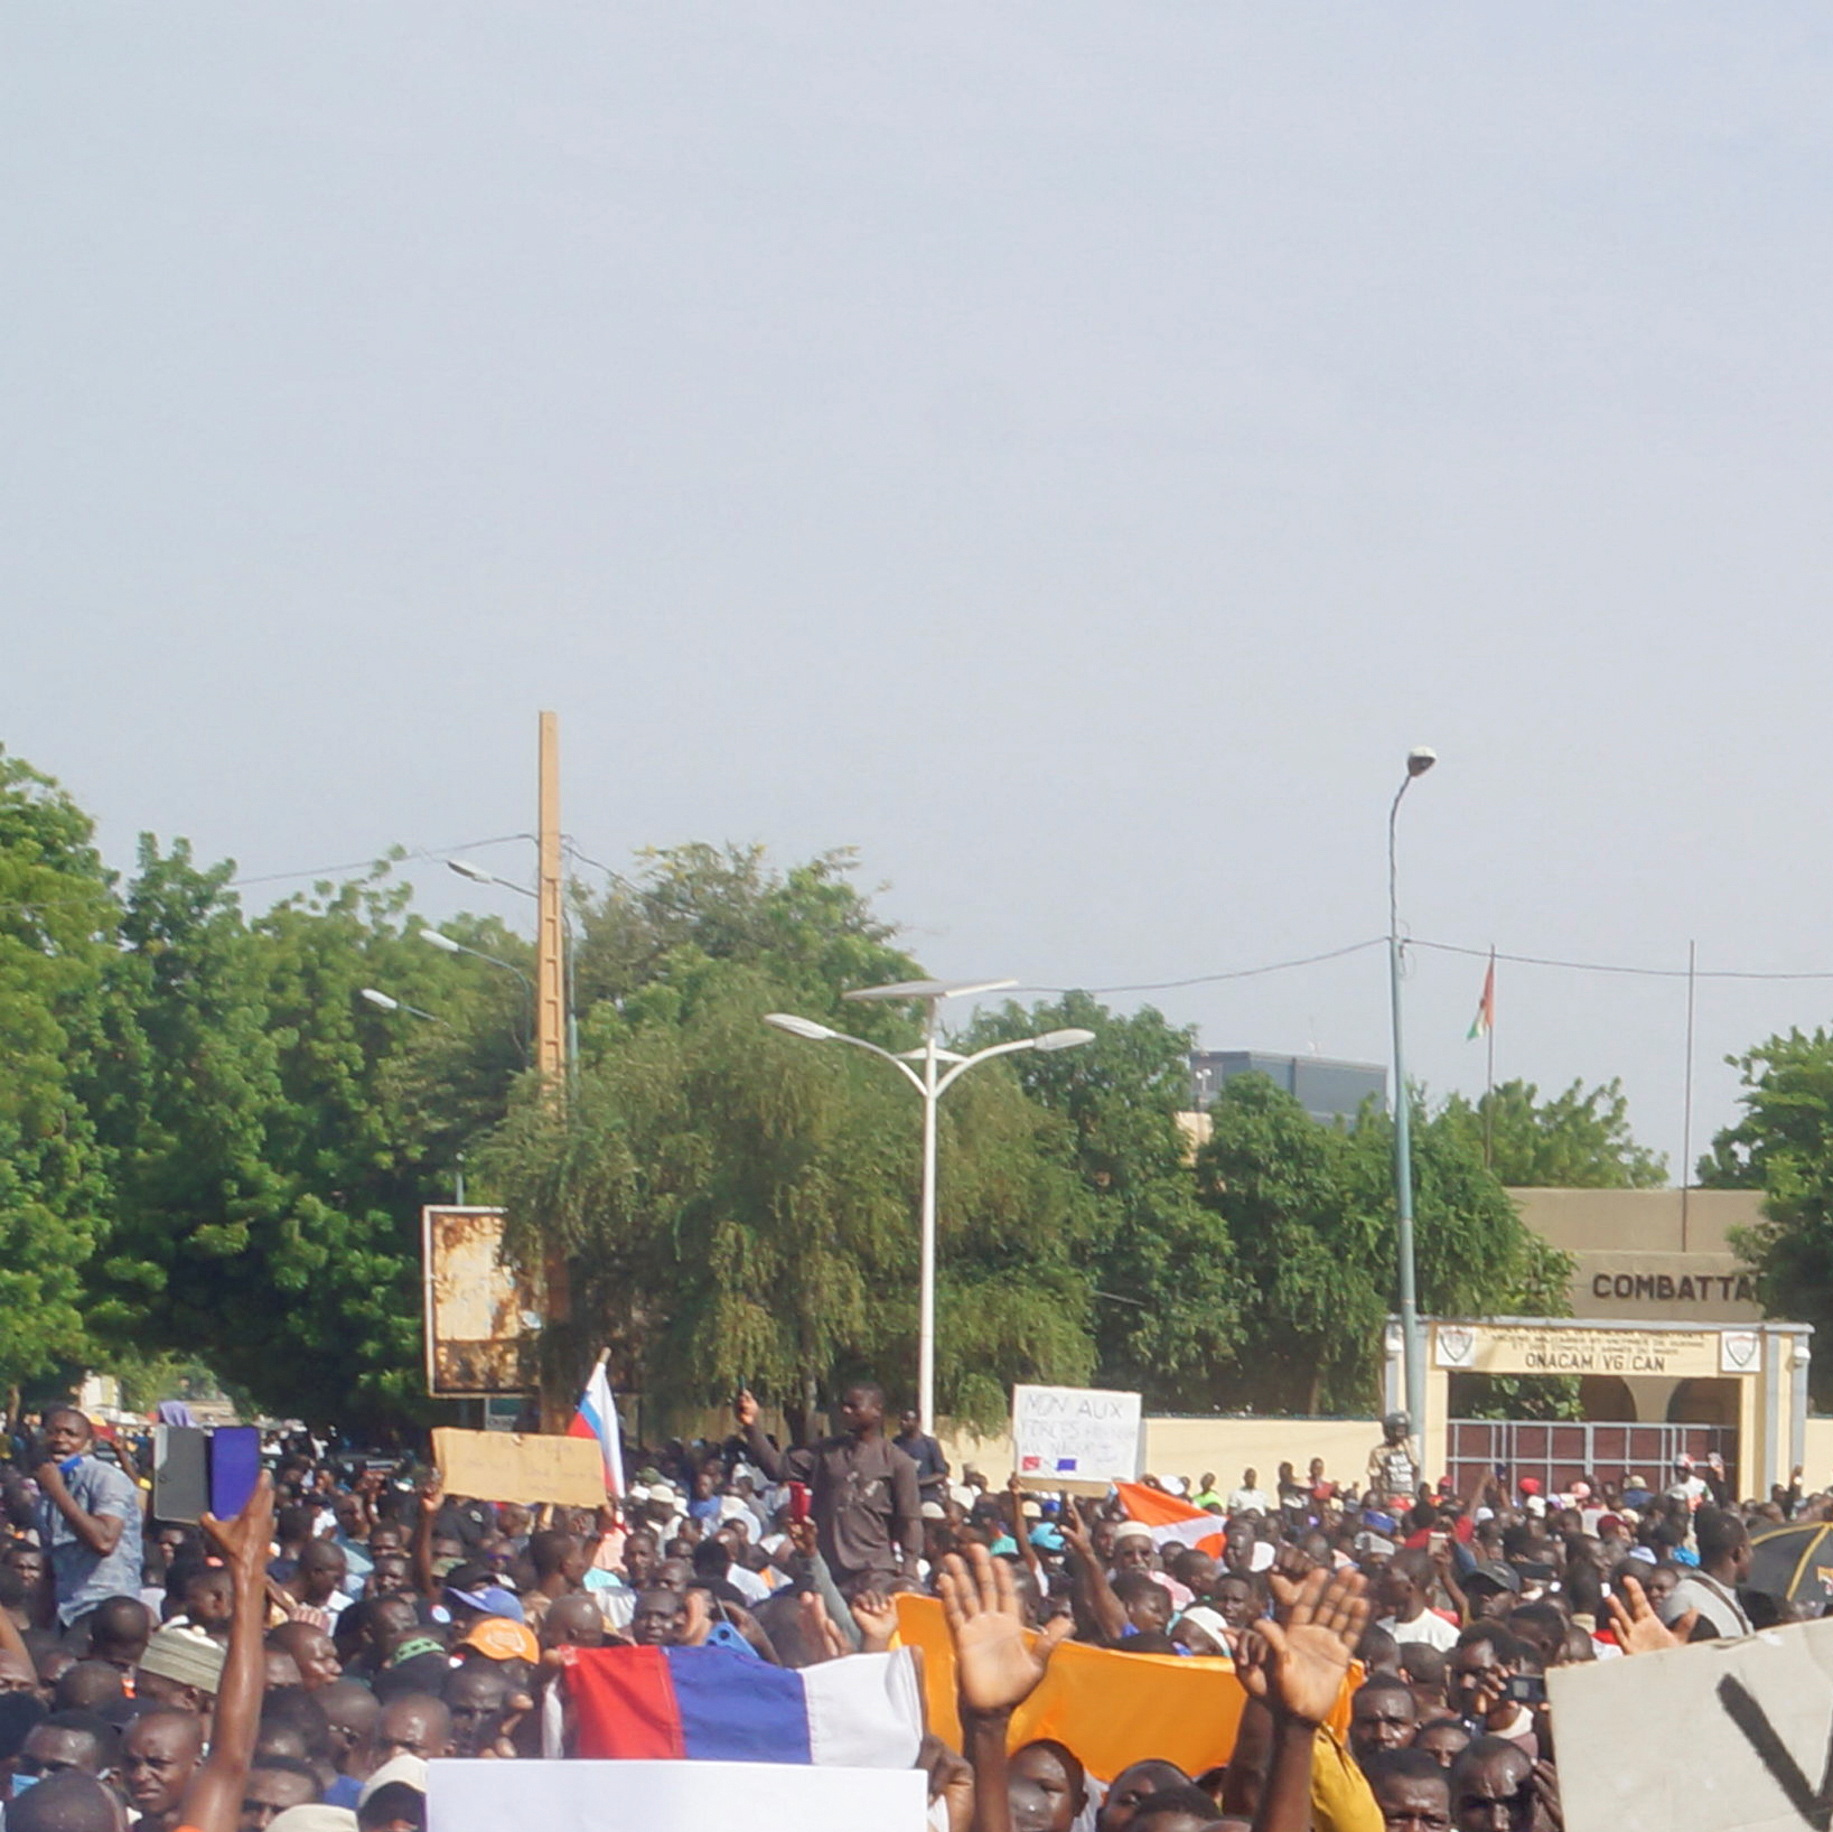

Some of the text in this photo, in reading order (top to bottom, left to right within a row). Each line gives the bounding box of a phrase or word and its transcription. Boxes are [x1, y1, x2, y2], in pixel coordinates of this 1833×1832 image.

[1592, 1273, 1764, 1301] COMBATTA
[1525, 1353, 1594, 1370] ONACAM
[1632, 1356, 1665, 1372] CAN
[1078, 1400, 1122, 1420] AUX
